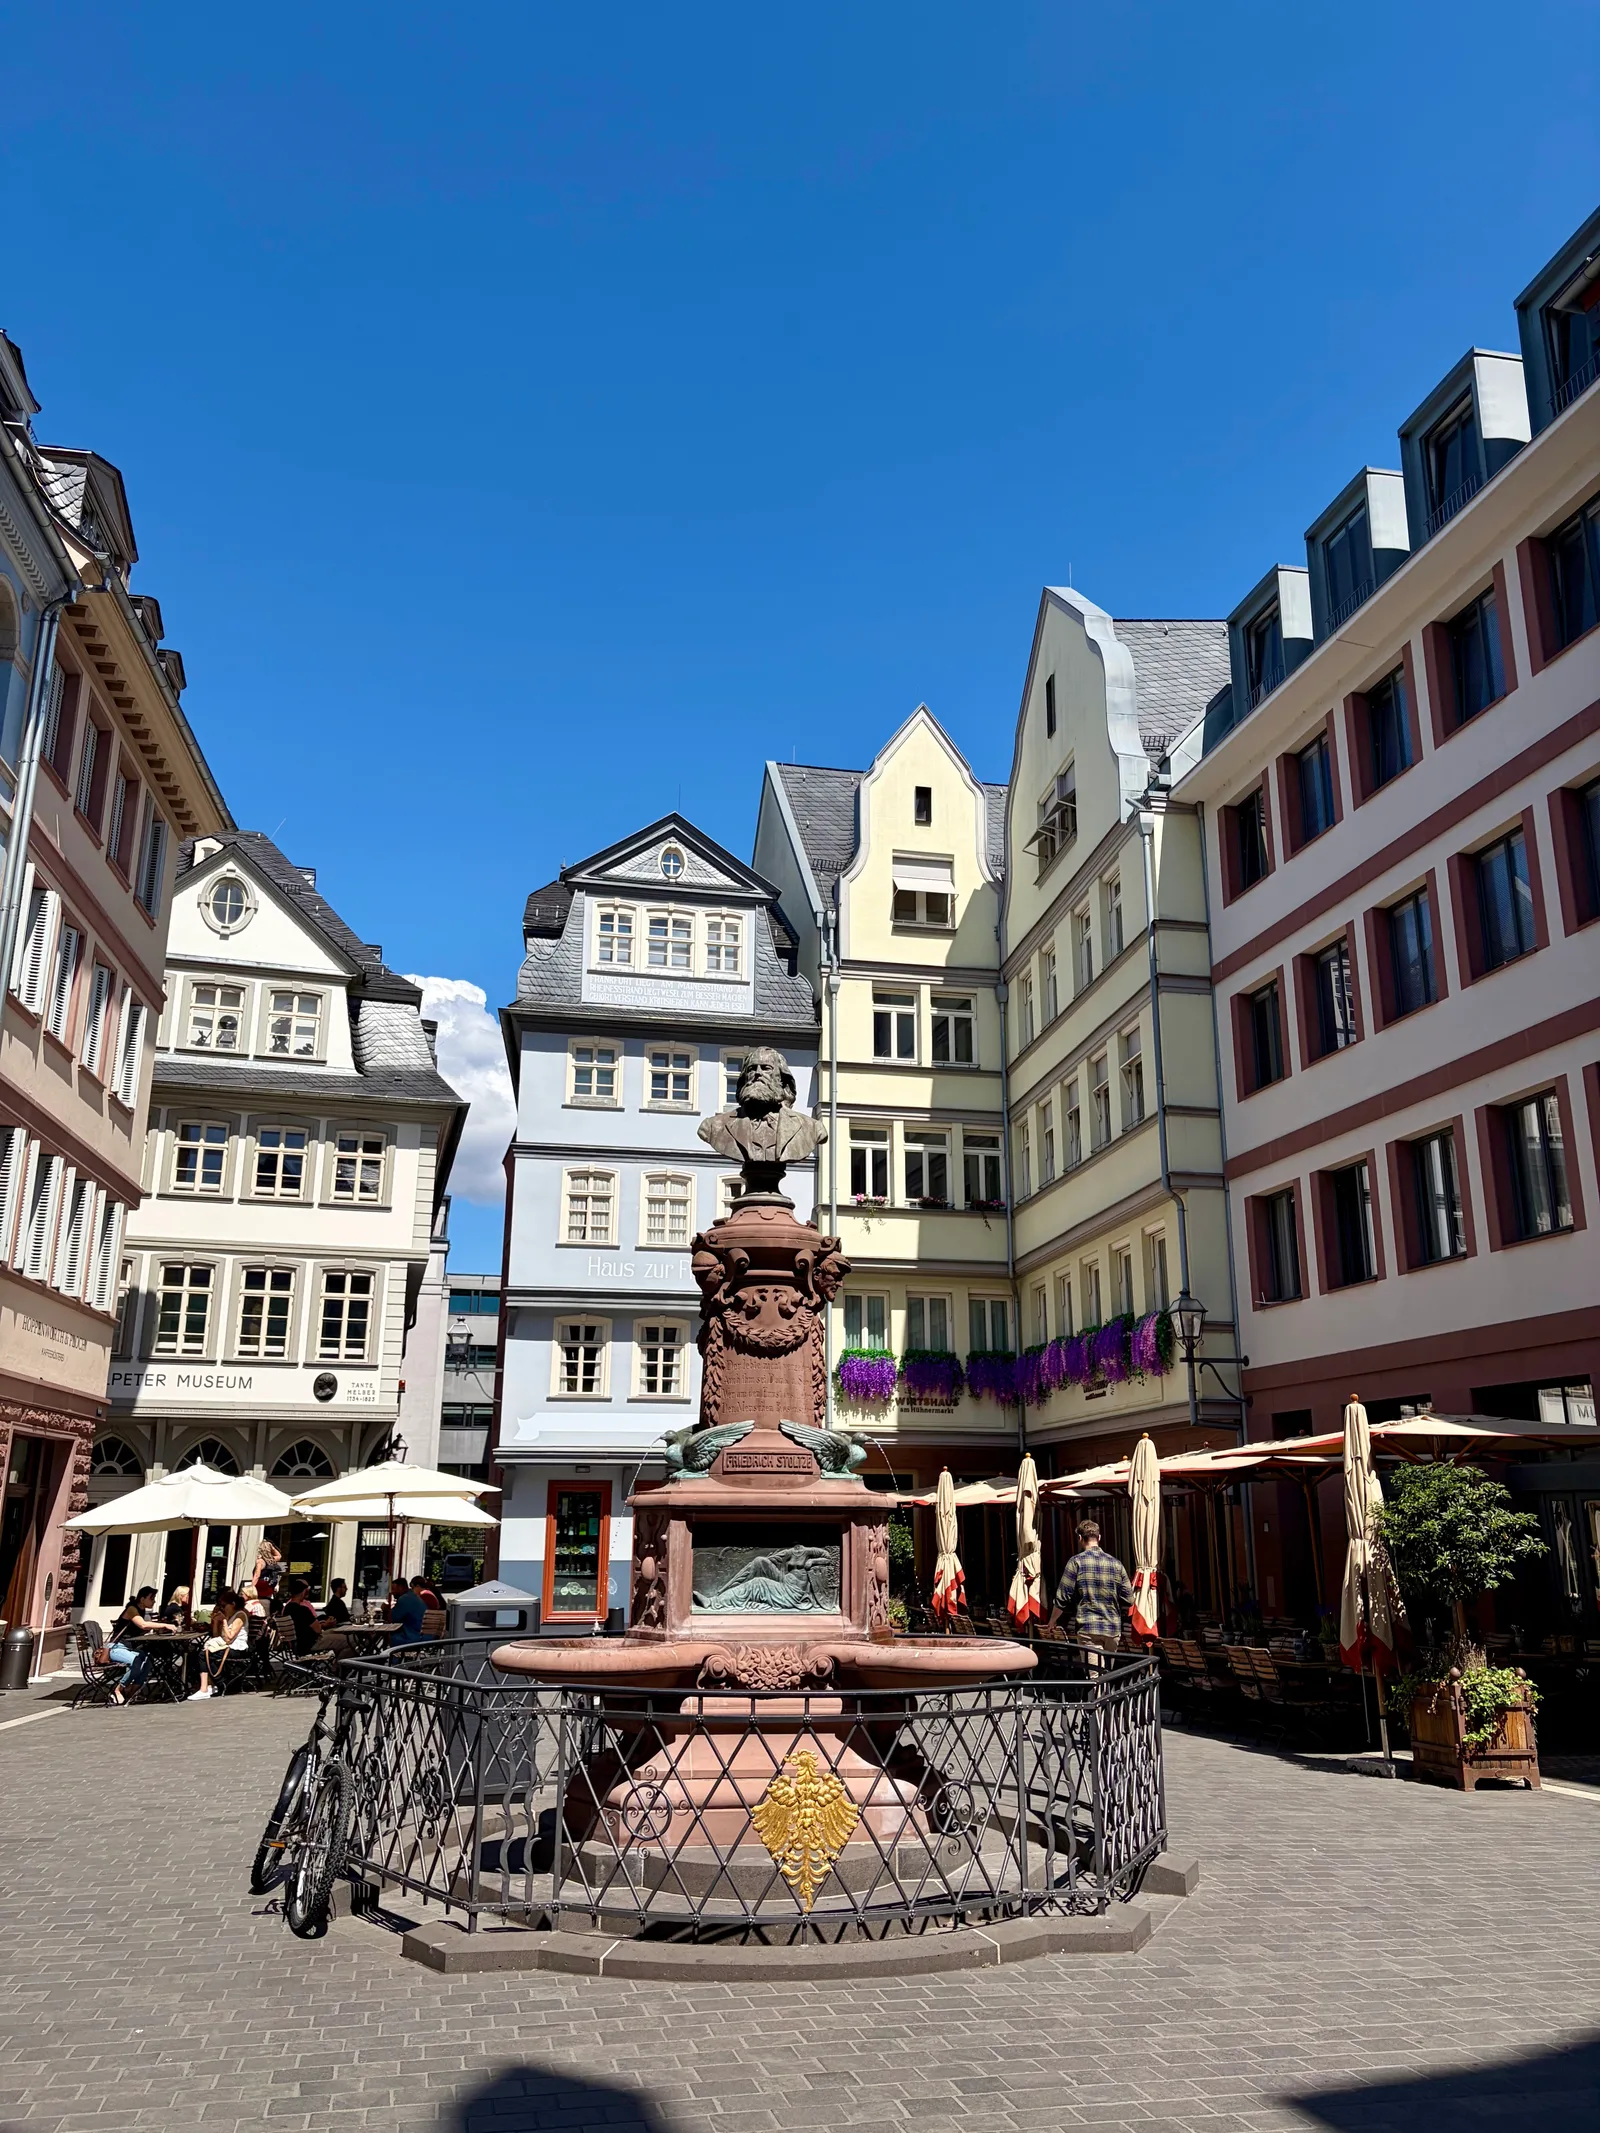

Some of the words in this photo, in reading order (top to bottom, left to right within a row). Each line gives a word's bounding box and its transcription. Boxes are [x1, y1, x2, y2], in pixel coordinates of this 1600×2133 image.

[589, 976, 632, 986] FRANKFURT
[635, 979, 655, 987] LIEGT
[613, 993, 648, 1004] VERSTAND
[731, 1002, 745, 1010] ESEL
[696, 991, 721, 1000] BESSER
[588, 1256, 635, 1278] Haus
[643, 1263, 674, 1279] zur
[107, 1372, 166, 1387] PETER
[176, 1374, 253, 1389] MUSEUM
[895, 1397, 960, 1407] WIRTSHAUS
[726, 1455, 773, 1469] FRIEDRICH
[776, 1456, 812, 1469] STOLTZE
